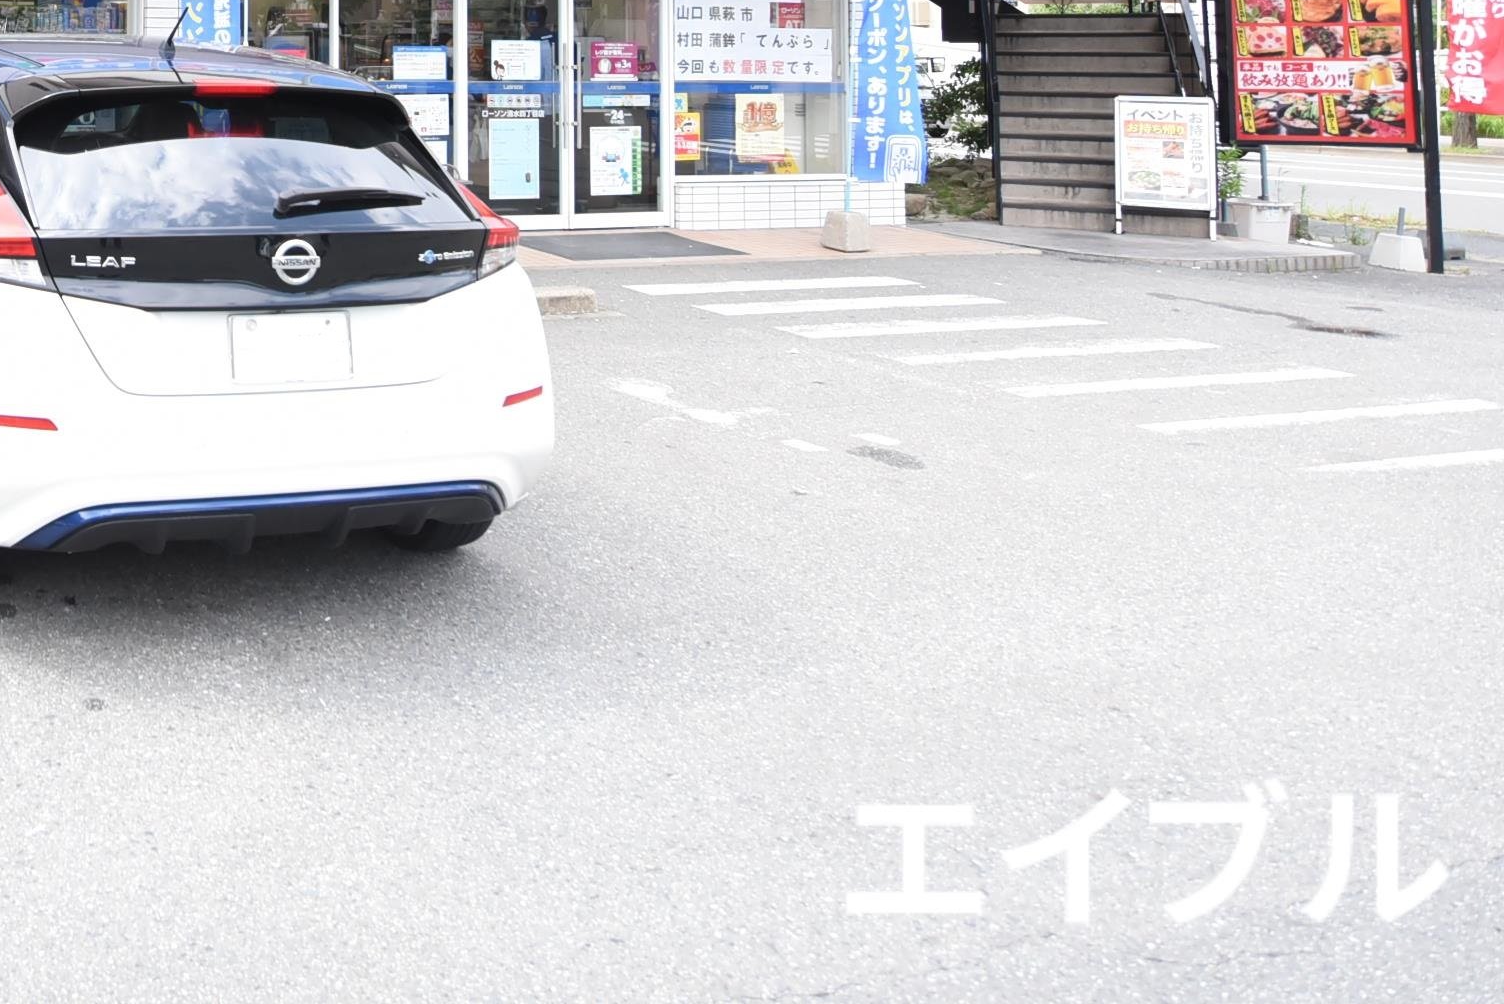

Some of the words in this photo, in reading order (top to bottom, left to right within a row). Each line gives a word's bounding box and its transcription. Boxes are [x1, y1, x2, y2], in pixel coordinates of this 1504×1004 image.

[1126, 108, 1184, 121] イベント
[71, 254, 137, 269] LEAF
[278, 257, 317, 267] NISSAN
